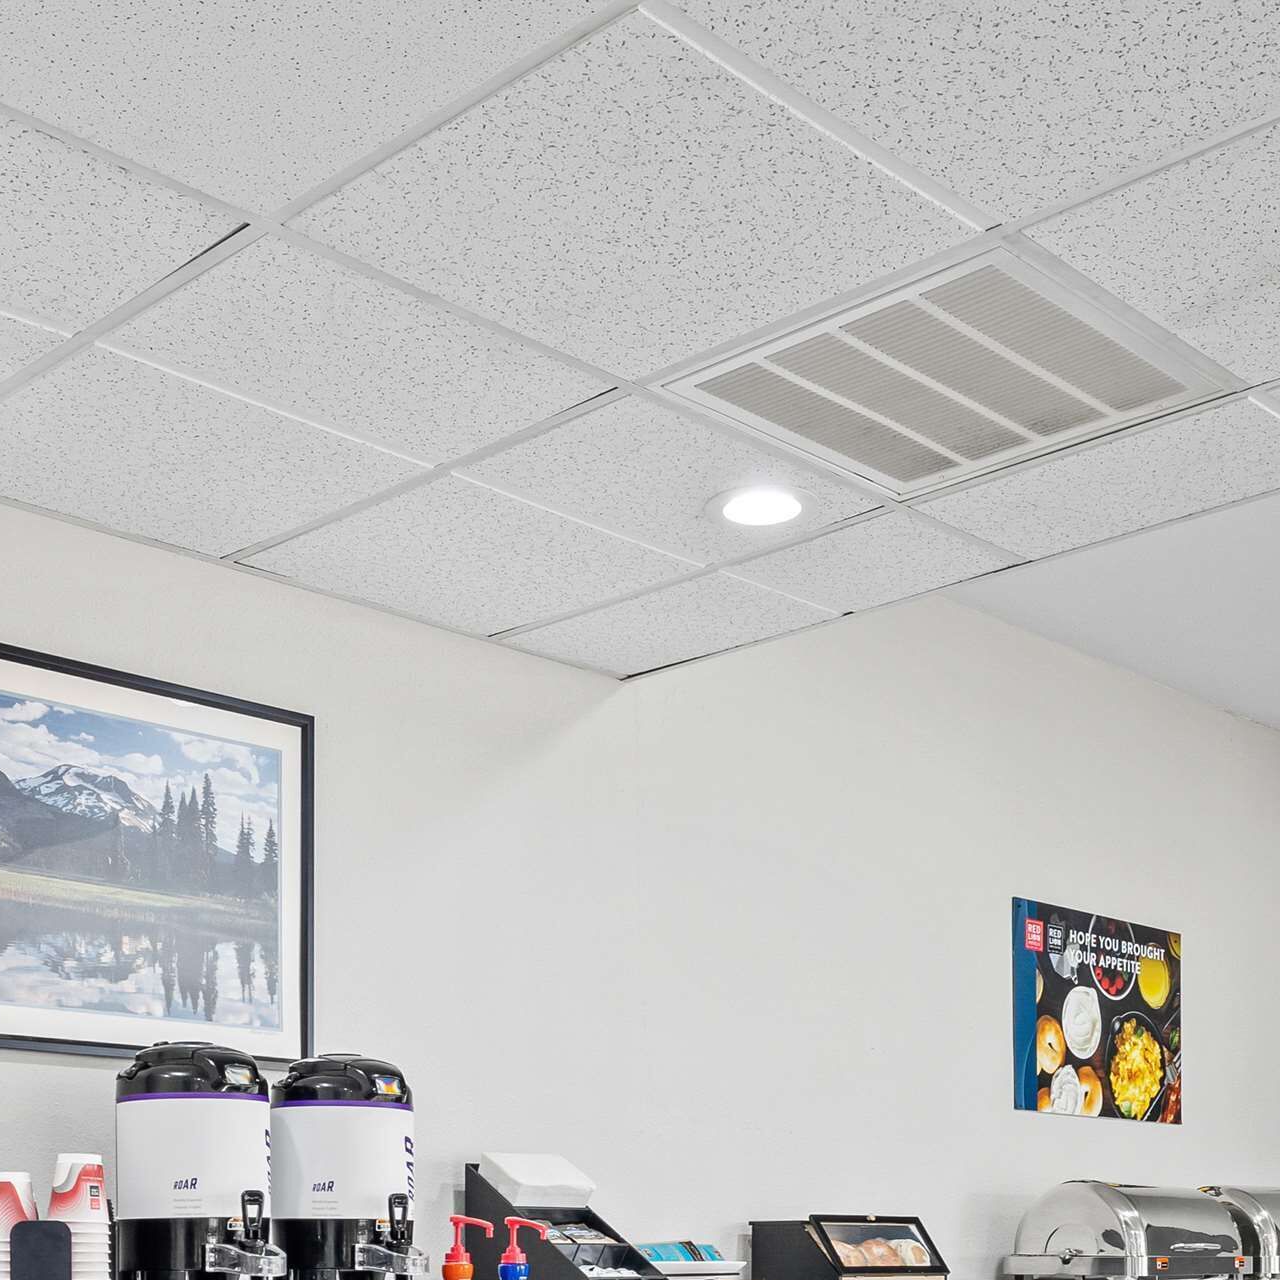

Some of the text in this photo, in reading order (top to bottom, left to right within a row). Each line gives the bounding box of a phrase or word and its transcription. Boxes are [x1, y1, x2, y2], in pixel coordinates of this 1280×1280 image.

[1049, 928, 1062, 938] RED
[1069, 929, 1166, 961] HOPE YOU BROUGHT
[1069, 949, 1141, 974] YOUR APPETITE
[173, 1177, 198, 1190] ROAR
[312, 1180, 335, 1192] ROAR
